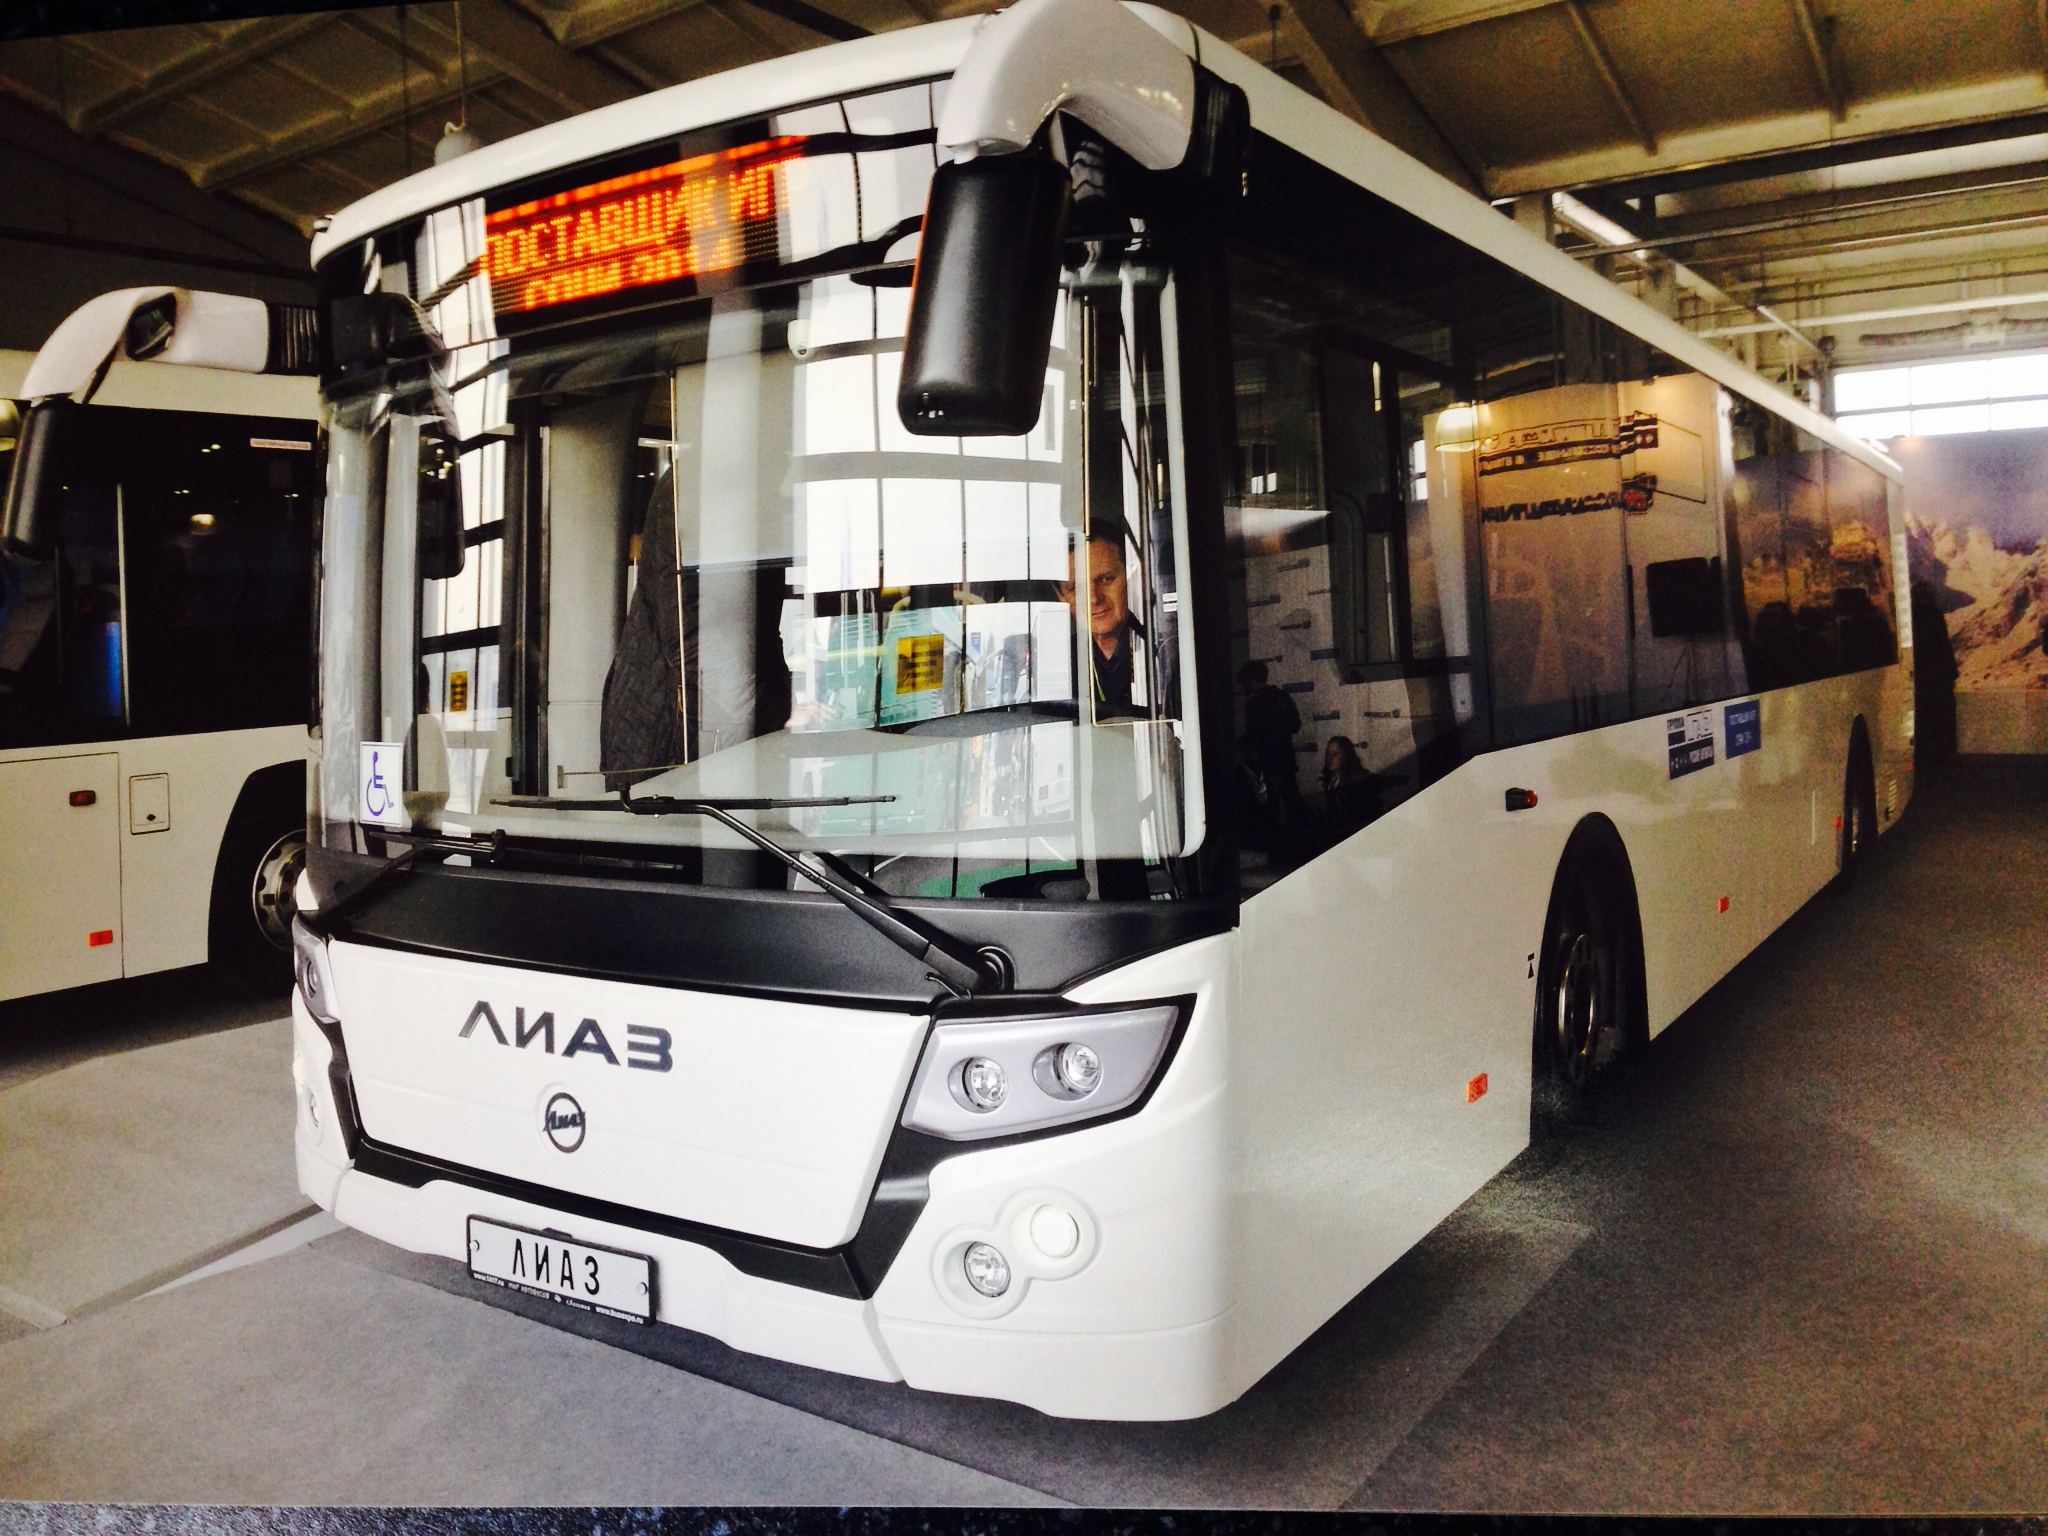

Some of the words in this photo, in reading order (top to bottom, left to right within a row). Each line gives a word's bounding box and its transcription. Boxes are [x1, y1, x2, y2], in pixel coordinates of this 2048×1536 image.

[486, 178, 717, 277] ПОСТАВЩИК
[458, 999, 674, 1074] ЛИАЗ
[512, 1238, 601, 1296] ЛИАЗ
